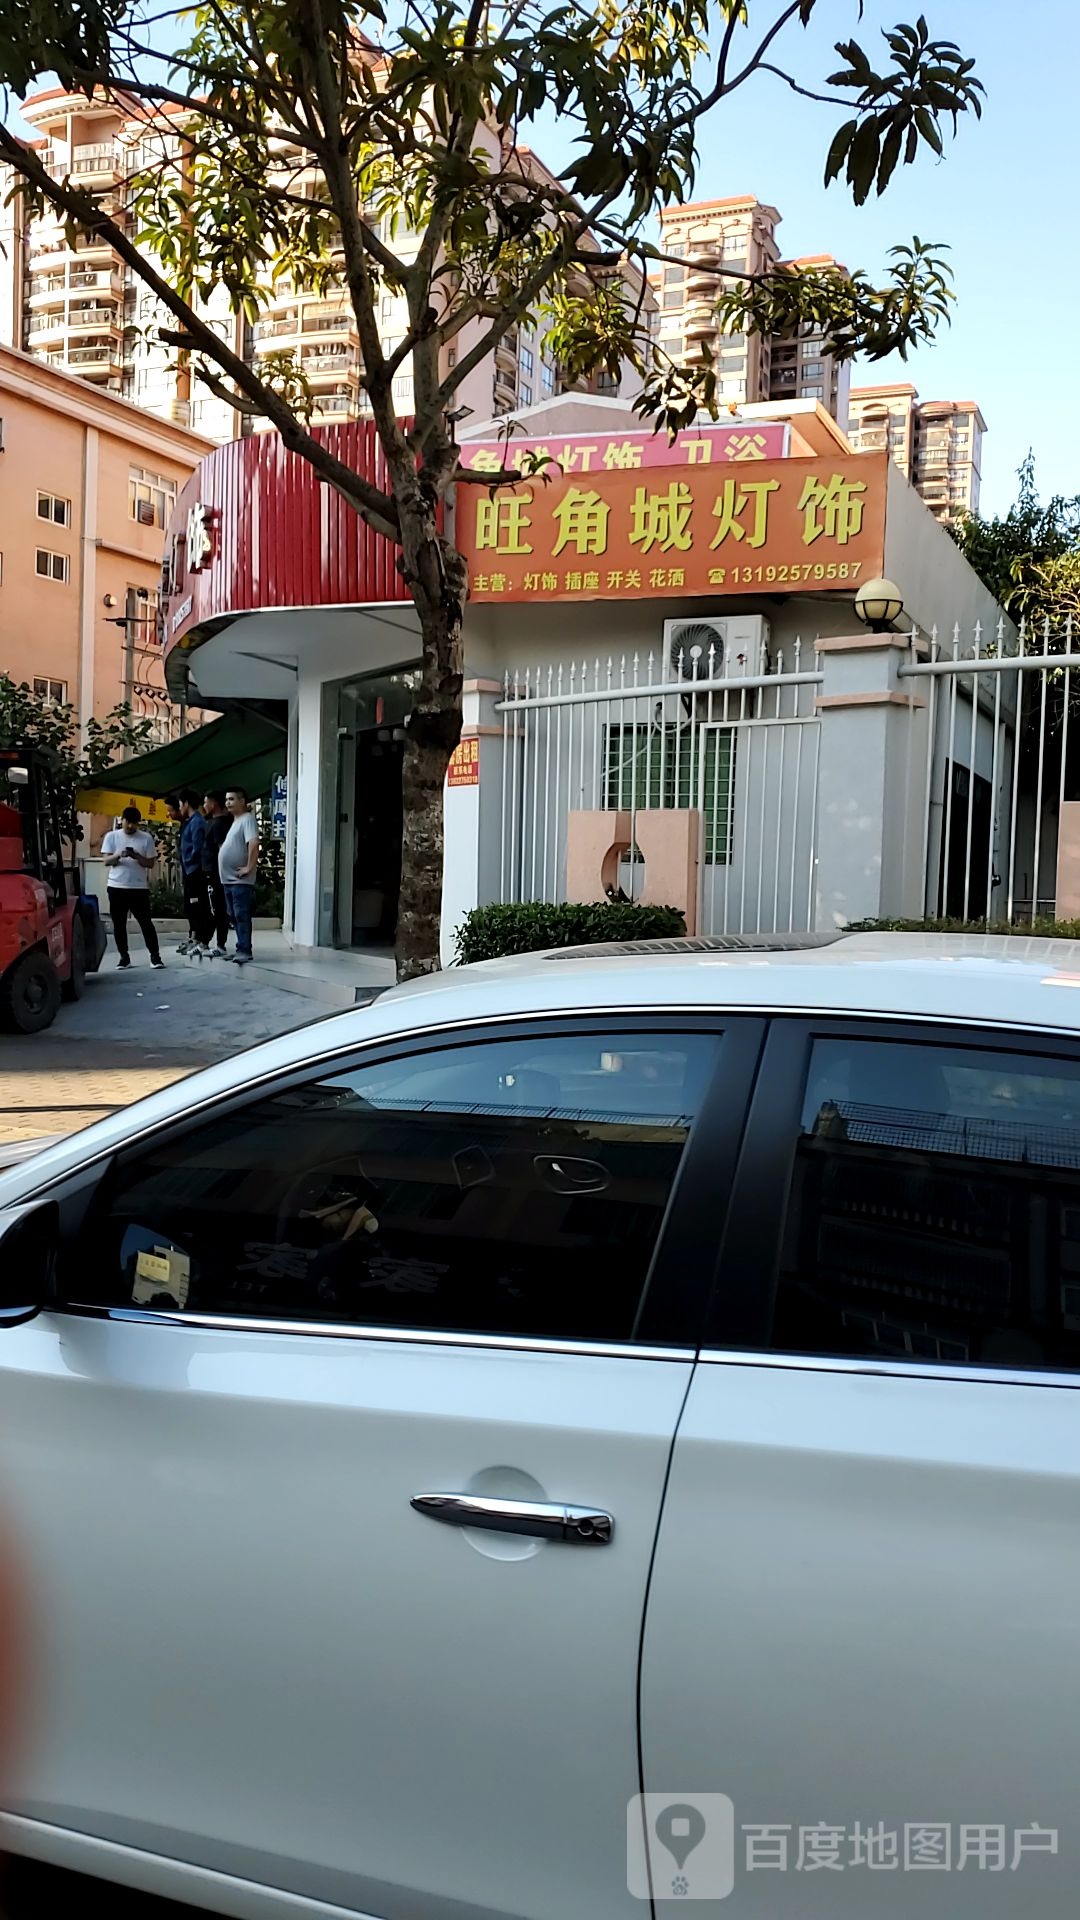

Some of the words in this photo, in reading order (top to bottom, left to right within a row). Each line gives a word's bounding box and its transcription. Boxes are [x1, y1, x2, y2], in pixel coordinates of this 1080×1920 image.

[475, 473, 868, 557] 旺角城灯饰
[473, 573, 513, 592] 主营：
[523, 571, 558, 591] 灯饰
[564, 571, 600, 591] 插座
[606, 569, 641, 589] 开关
[649, 567, 685, 589] 花洒
[731, 562, 862, 584] 13192579587
